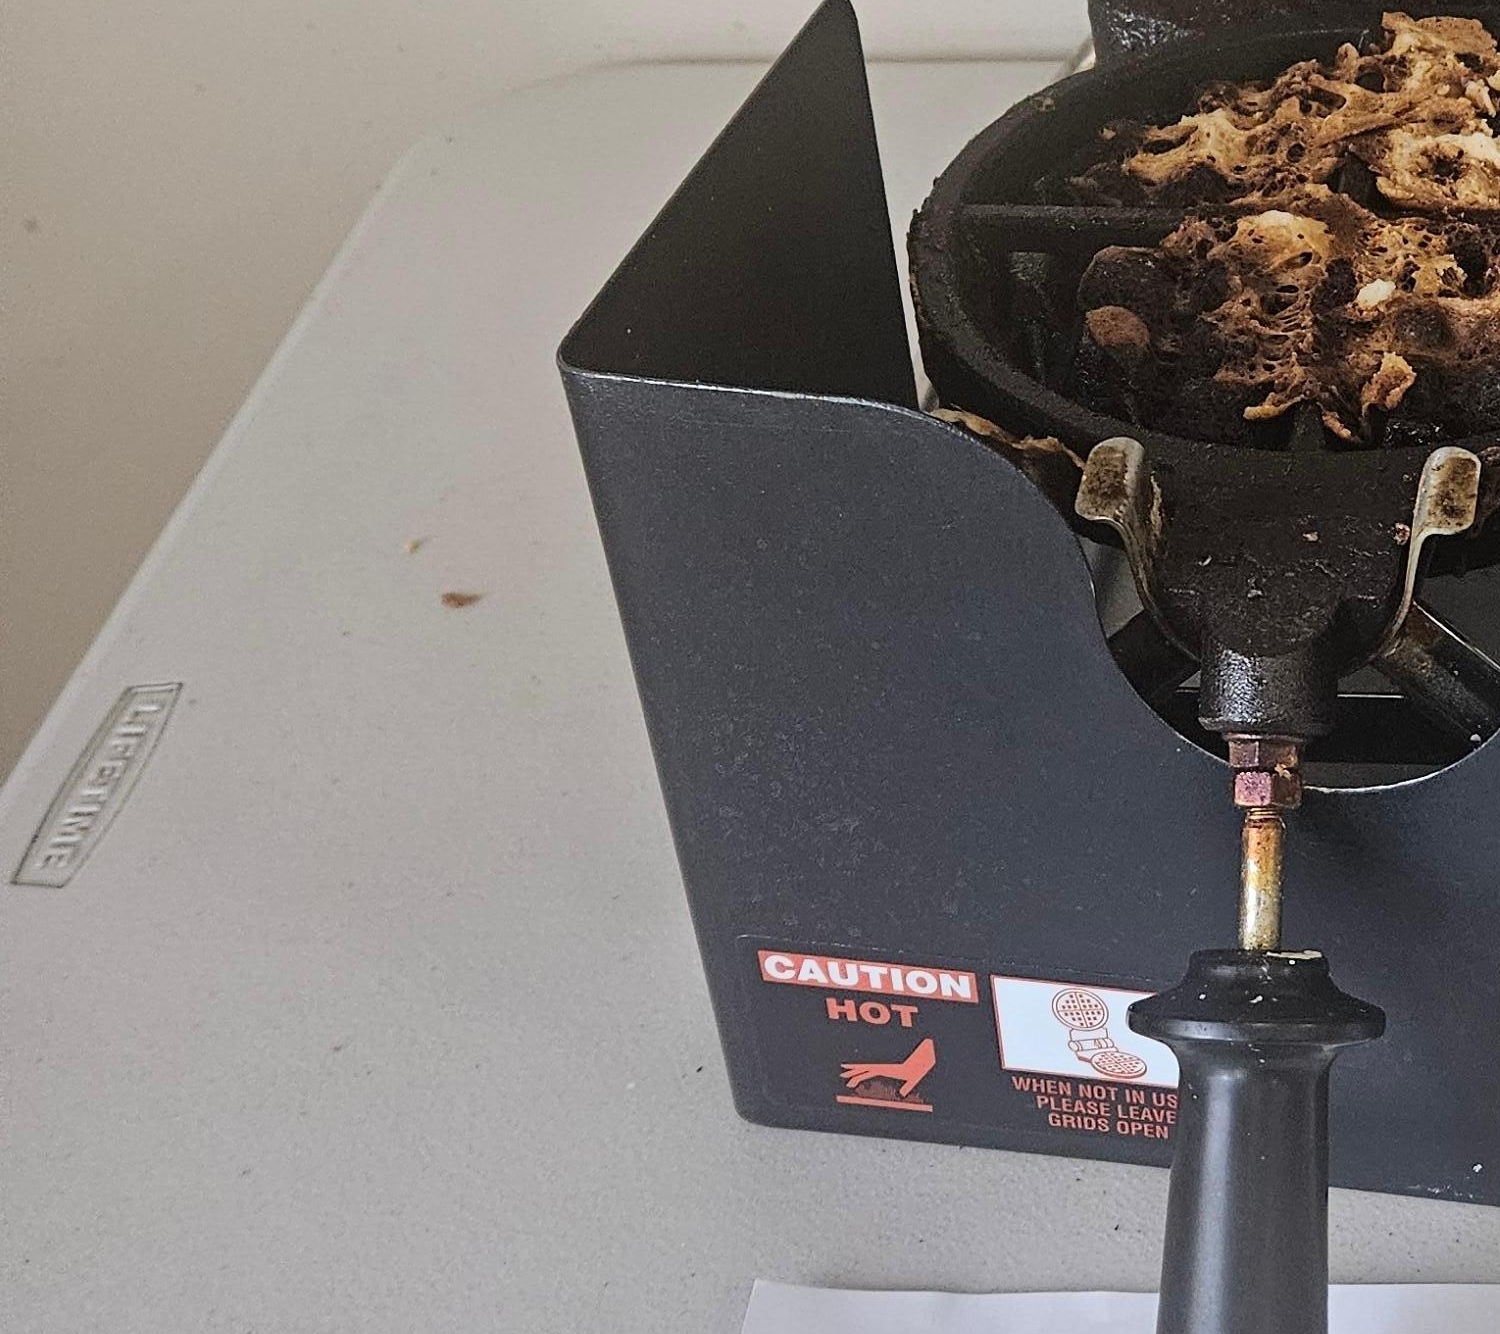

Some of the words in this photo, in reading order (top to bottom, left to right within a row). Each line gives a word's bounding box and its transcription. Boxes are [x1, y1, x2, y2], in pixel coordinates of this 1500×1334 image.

[762, 953, 973, 1000] CAUTION
[825, 997, 919, 1029] HOT
[1012, 1075, 1072, 1097] WHEN
[1078, 1083, 1119, 1102] NOT
[1125, 1088, 1145, 1105] IN
[1151, 1091, 1179, 1110] US
[1036, 1095, 1111, 1117] PLEASE
[1116, 1103, 1178, 1125] LEAVE
[1047, 1112, 1110, 1133] GRIDS
[1116, 1120, 1170, 1140] OPEN
